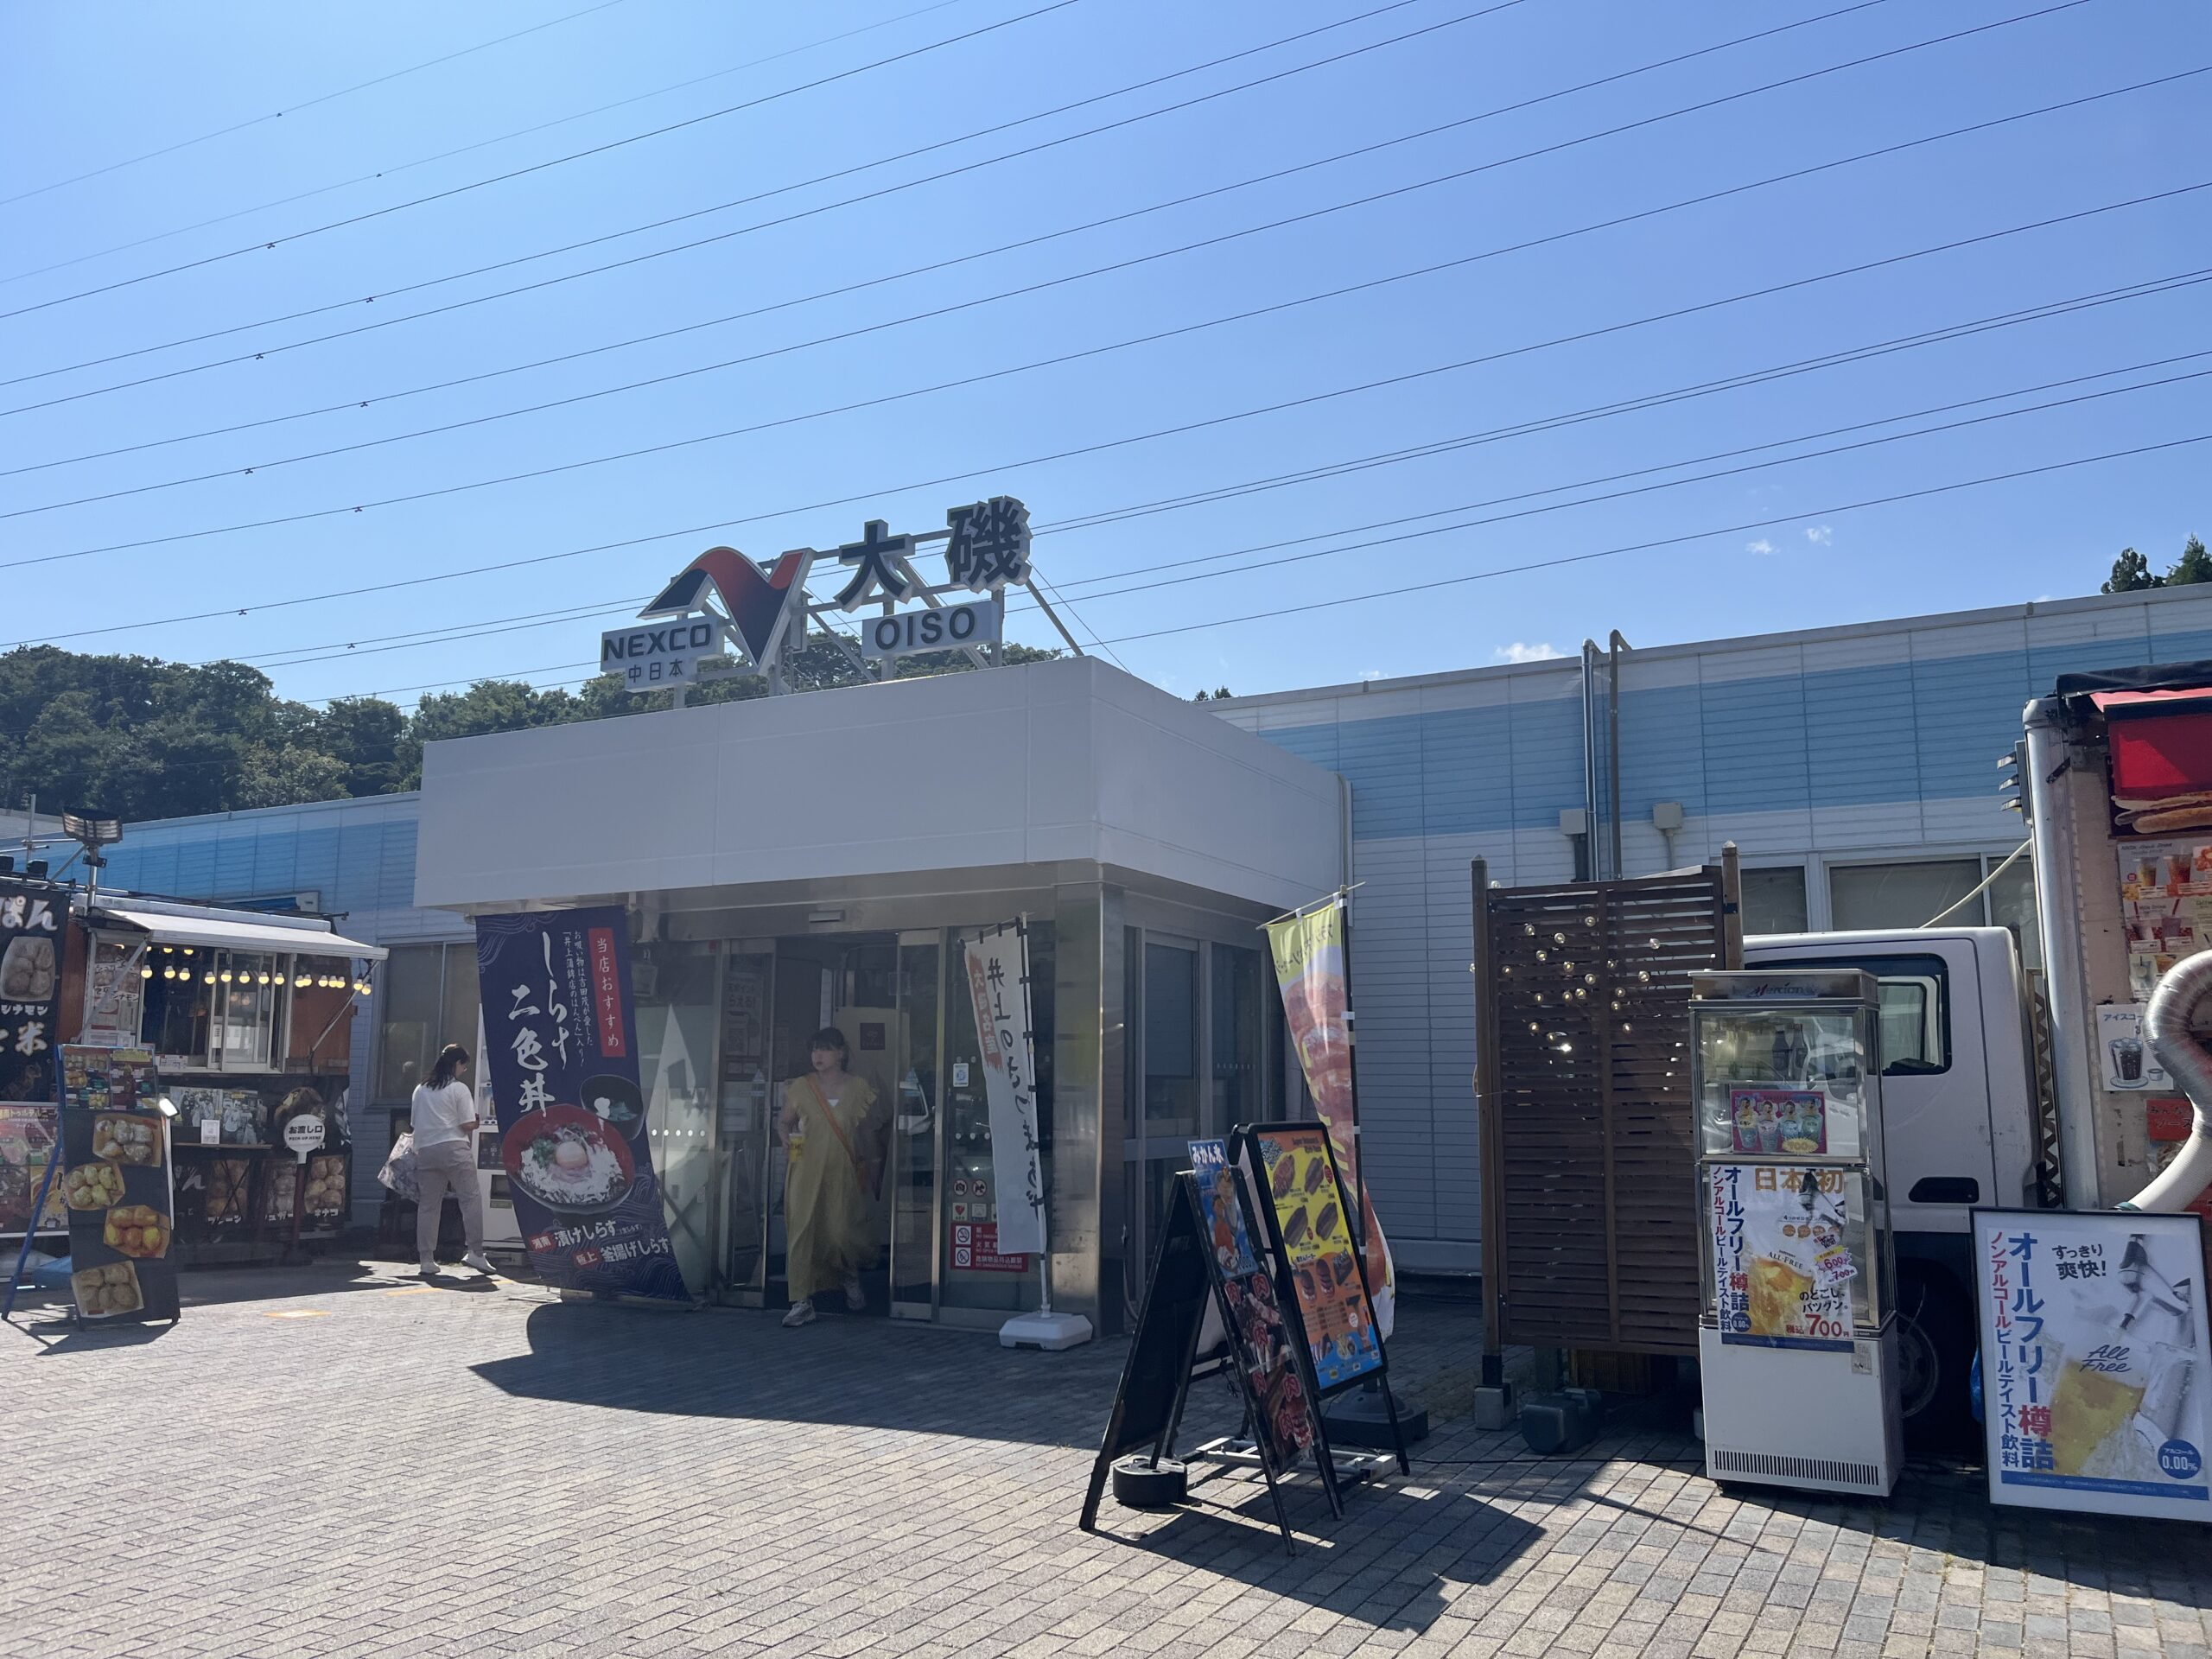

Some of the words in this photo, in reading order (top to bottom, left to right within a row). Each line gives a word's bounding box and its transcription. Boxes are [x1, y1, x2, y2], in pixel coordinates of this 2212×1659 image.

[834, 496, 1030, 612] 大磯
[603, 623, 712, 661] NEXCO
[874, 607, 976, 650] OISO
[627, 658, 683, 684] 中日本
[542, 931, 569, 1071] しらす
[574, 931, 594, 1046] お吸い物は吉田茂が愛した
[597, 938, 620, 1047] 当店おすすめ
[507, 984, 556, 1117] 二色丼
[289, 1125, 322, 1135] お渡し口
[1192, 1143, 1224, 1164] みかん氷
[1755, 1167, 1843, 1194] 日本初
[531, 1235, 552, 1250] 湘南
[554, 1219, 617, 1248] 漬けしらす
[1713, 1166, 1731, 1332] ノンアルコールビールテイスト飲料
[1724, 1166, 1749, 1312] オールフリー樽詰
[575, 1251, 598, 1266] 極上
[600, 1236, 669, 1263] 釜揚げしらす
[1767, 1251, 1803, 1270] ALL-FREE
[2052, 1243, 2103, 1259] すっきり
[2056, 1261, 2107, 1280] 爽快!
[1991, 1231, 2019, 1468] ノンアルコールビールテイスト飲料
[2008, 1232, 2054, 1471] オールフリー樽詰
[2088, 1344, 2131, 1361] All
[2079, 1358, 2132, 1373] Free
[2162, 1455, 2199, 1471] 0.00%
[2163, 1446, 2195, 1455] アルコール
